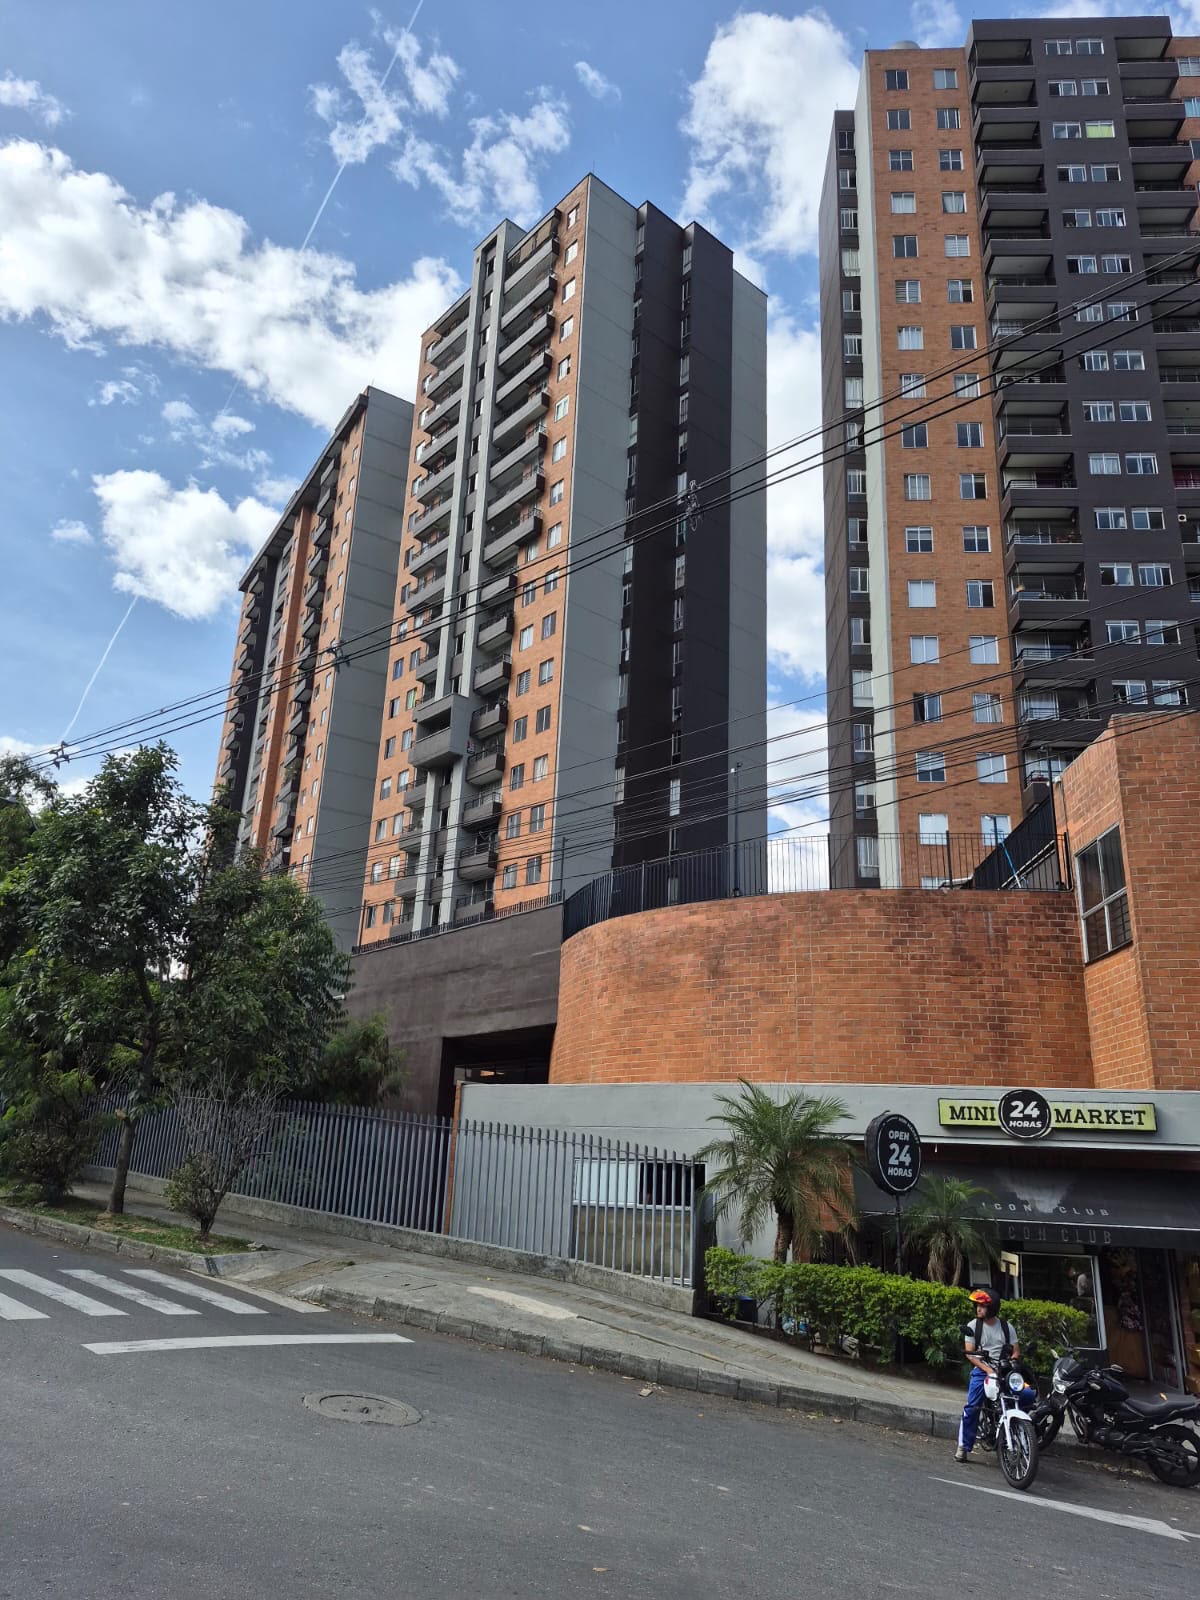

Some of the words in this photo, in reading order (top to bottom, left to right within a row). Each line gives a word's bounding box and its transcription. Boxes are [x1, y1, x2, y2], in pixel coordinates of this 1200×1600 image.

[949, 1105, 996, 1121] MINI
[1054, 1108, 1146, 1125] MARKET
[1010, 1101, 1040, 1118] 24
[1009, 1120, 1042, 1128] HORAS
[888, 1130, 909, 1141] OPEN
[888, 1143, 911, 1166] 24
[888, 1167, 912, 1178] HORAS
[1059, 1206, 1109, 1216] CLUB
[1061, 1227, 1111, 1244] CLUB
